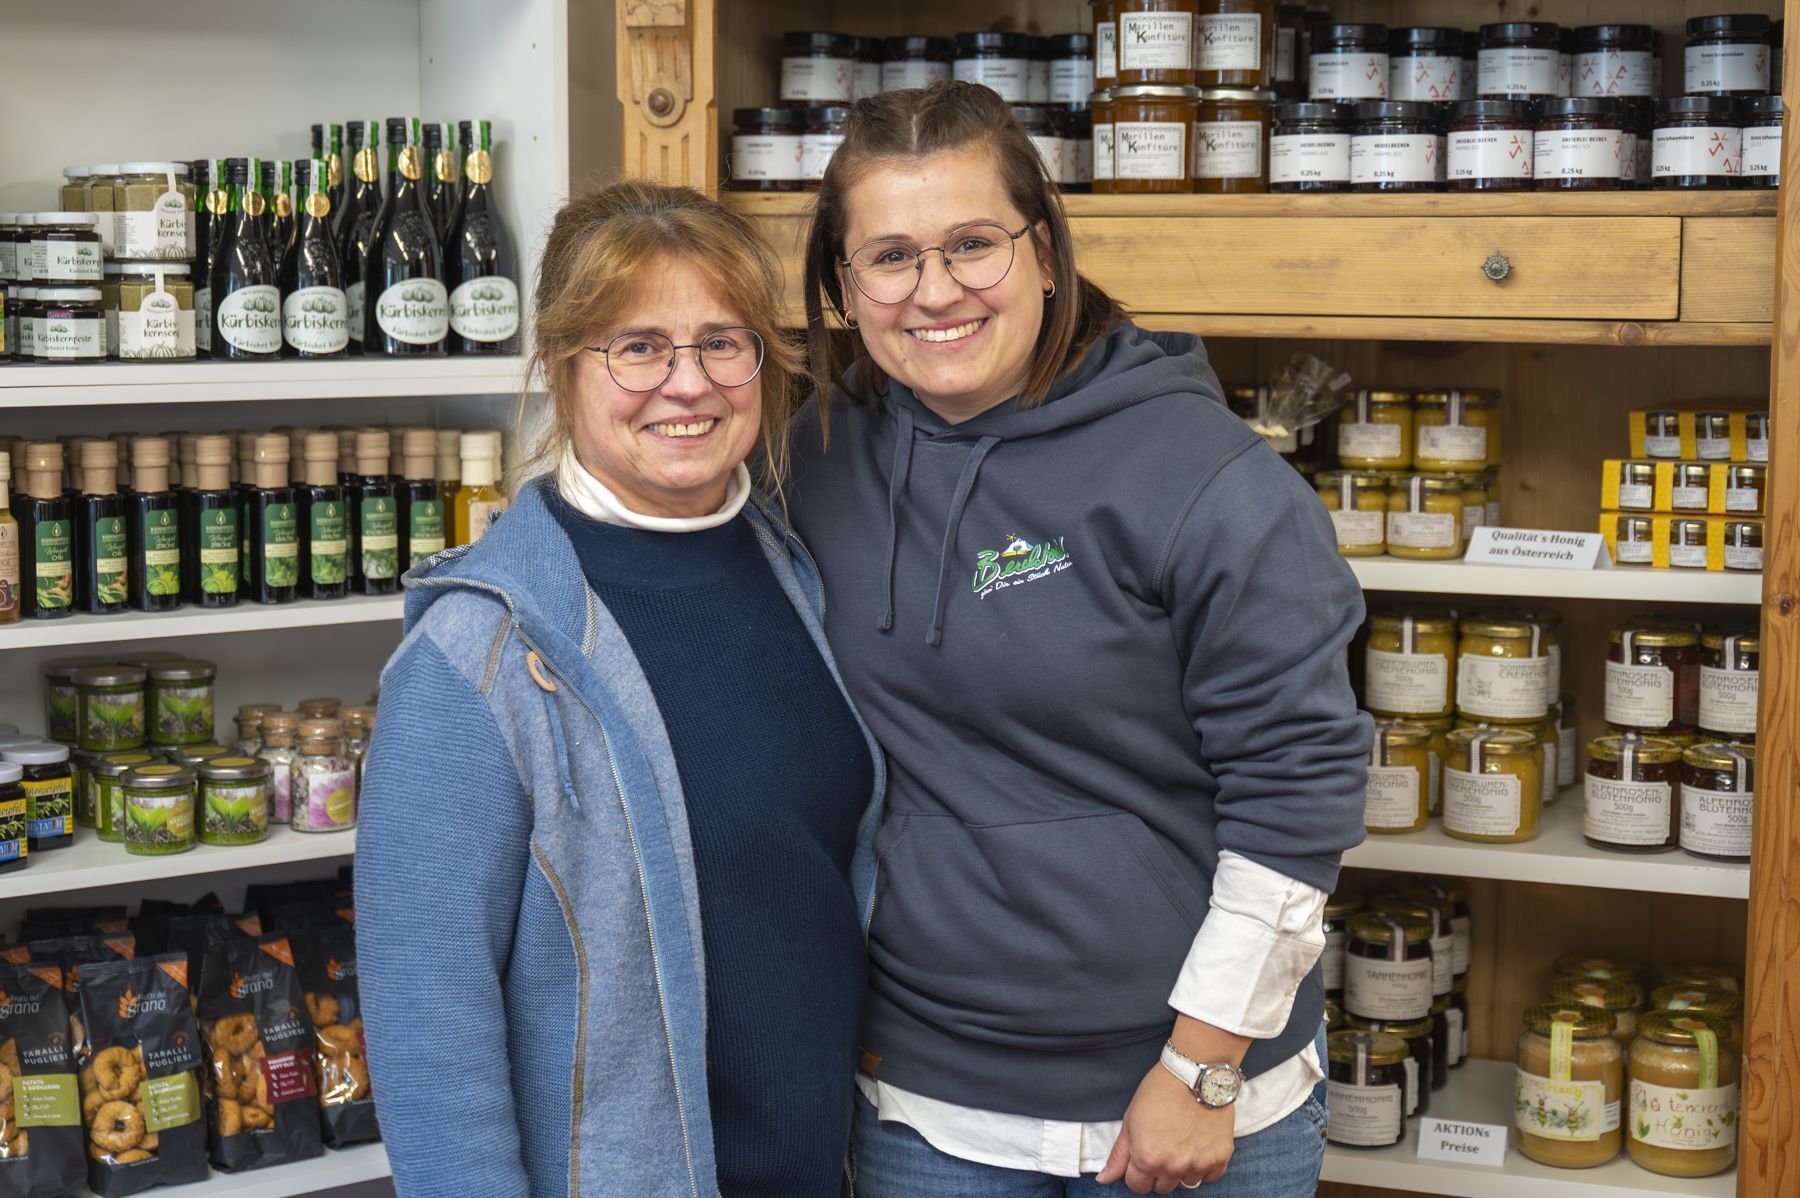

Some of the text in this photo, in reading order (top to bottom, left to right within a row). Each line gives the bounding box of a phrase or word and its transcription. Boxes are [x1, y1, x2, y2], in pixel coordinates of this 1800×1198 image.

[1129, 22, 1174, 34] Marillen
[1121, 132, 1165, 145] Marillen
[1387, 170, 1394, 178] kg
[1550, 534, 1586, 548] Honig
[1489, 546, 1574, 561] aus Österreich
[995, 580, 1010, 591] Dir
[1013, 578, 1025, 586] ein
[1718, 692, 1737, 701] 500g
[1614, 803, 1634, 813] 500g
[1727, 814, 1748, 825] 500g
[237, 978, 274, 999] grano
[0, 1002, 39, 1020] grano
[128, 999, 167, 1019] grano
[264, 1020, 300, 1035] TARALLI
[265, 1028, 305, 1042] PUGLIESI
[22, 1045, 63, 1058] TARALLI
[148, 1046, 187, 1060] TARALLI
[24, 1053, 68, 1065] PUGLIESI
[149, 1053, 192, 1069] PUGLIESI
[1434, 1122, 1490, 1138] AKTIONs
[1440, 1140, 1480, 1154] Preise
